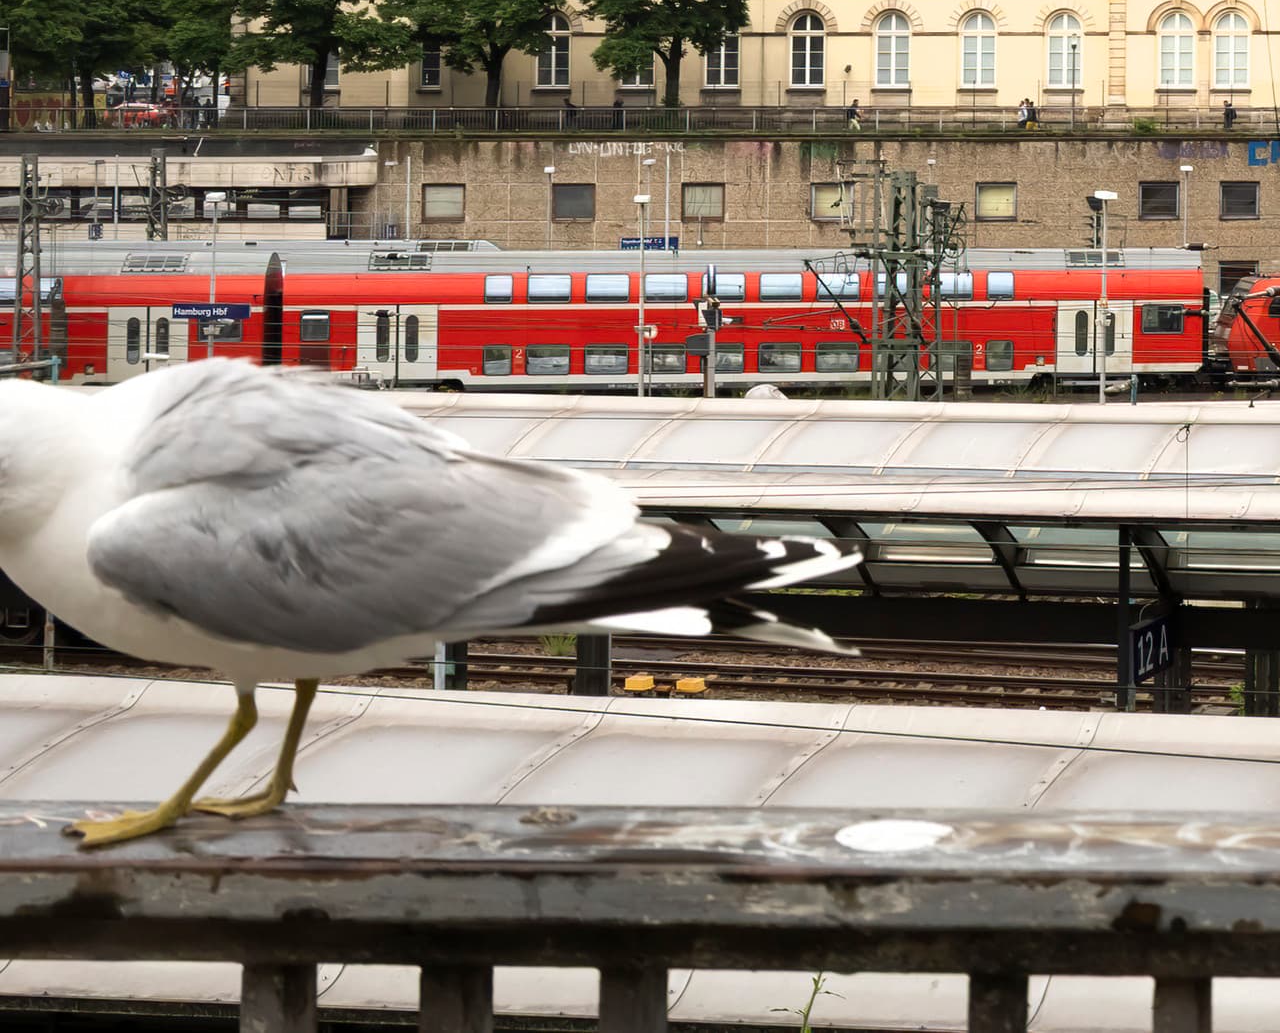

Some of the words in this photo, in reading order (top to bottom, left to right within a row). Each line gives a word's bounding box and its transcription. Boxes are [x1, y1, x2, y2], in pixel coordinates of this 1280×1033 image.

[174, 308, 211, 317] Hamburg
[212, 307, 228, 316] Hbf
[515, 349, 522, 359] 2
[976, 344, 983, 355] 2
[1138, 631, 1154, 676] 12
[1159, 624, 1169, 666] A
